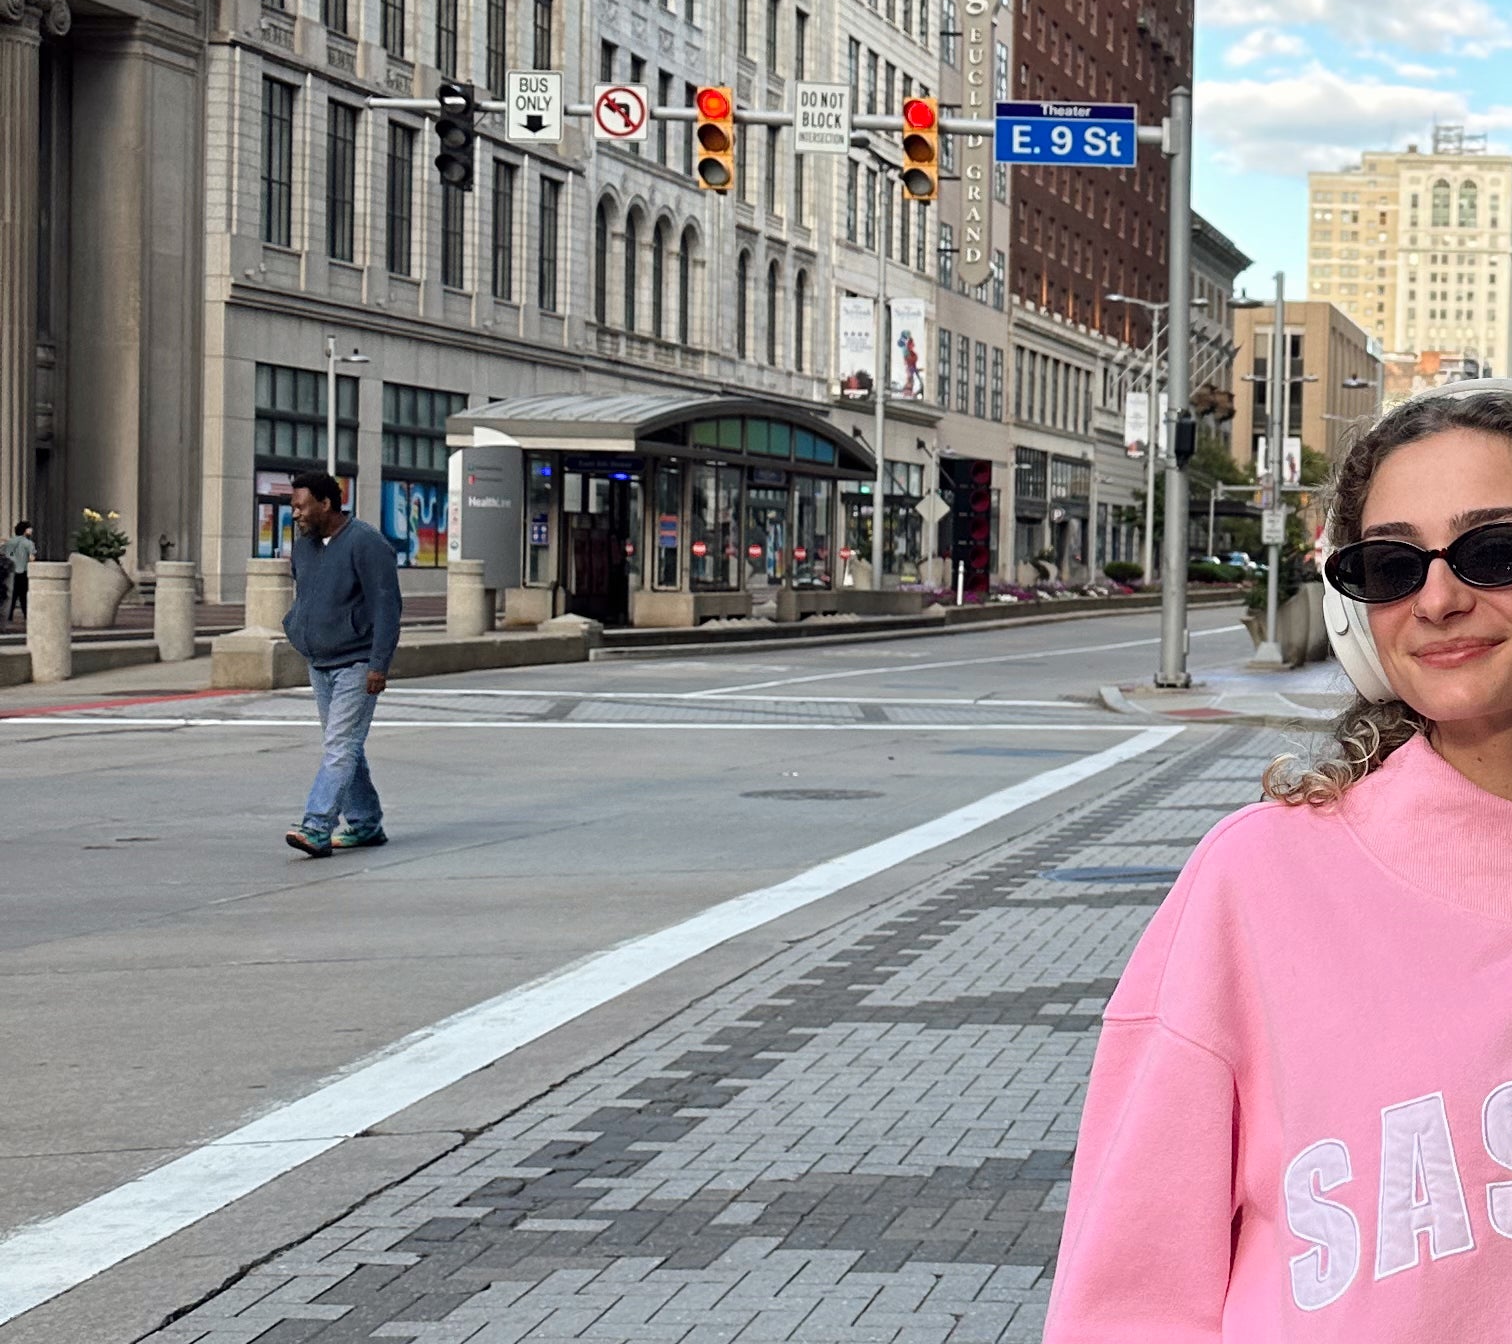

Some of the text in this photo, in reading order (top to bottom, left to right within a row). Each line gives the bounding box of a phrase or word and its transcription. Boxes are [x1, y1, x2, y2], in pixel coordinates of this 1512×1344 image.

[519, 77, 549, 93] BUS
[515, 96, 552, 112] ONLY
[801, 90, 845, 110] DO NOT
[802, 111, 842, 129] BLOCK
[1041, 104, 1092, 118] Theater
[1012, 124, 1122, 157] E. 9 St
[966, 163, 982, 263] GRAND
